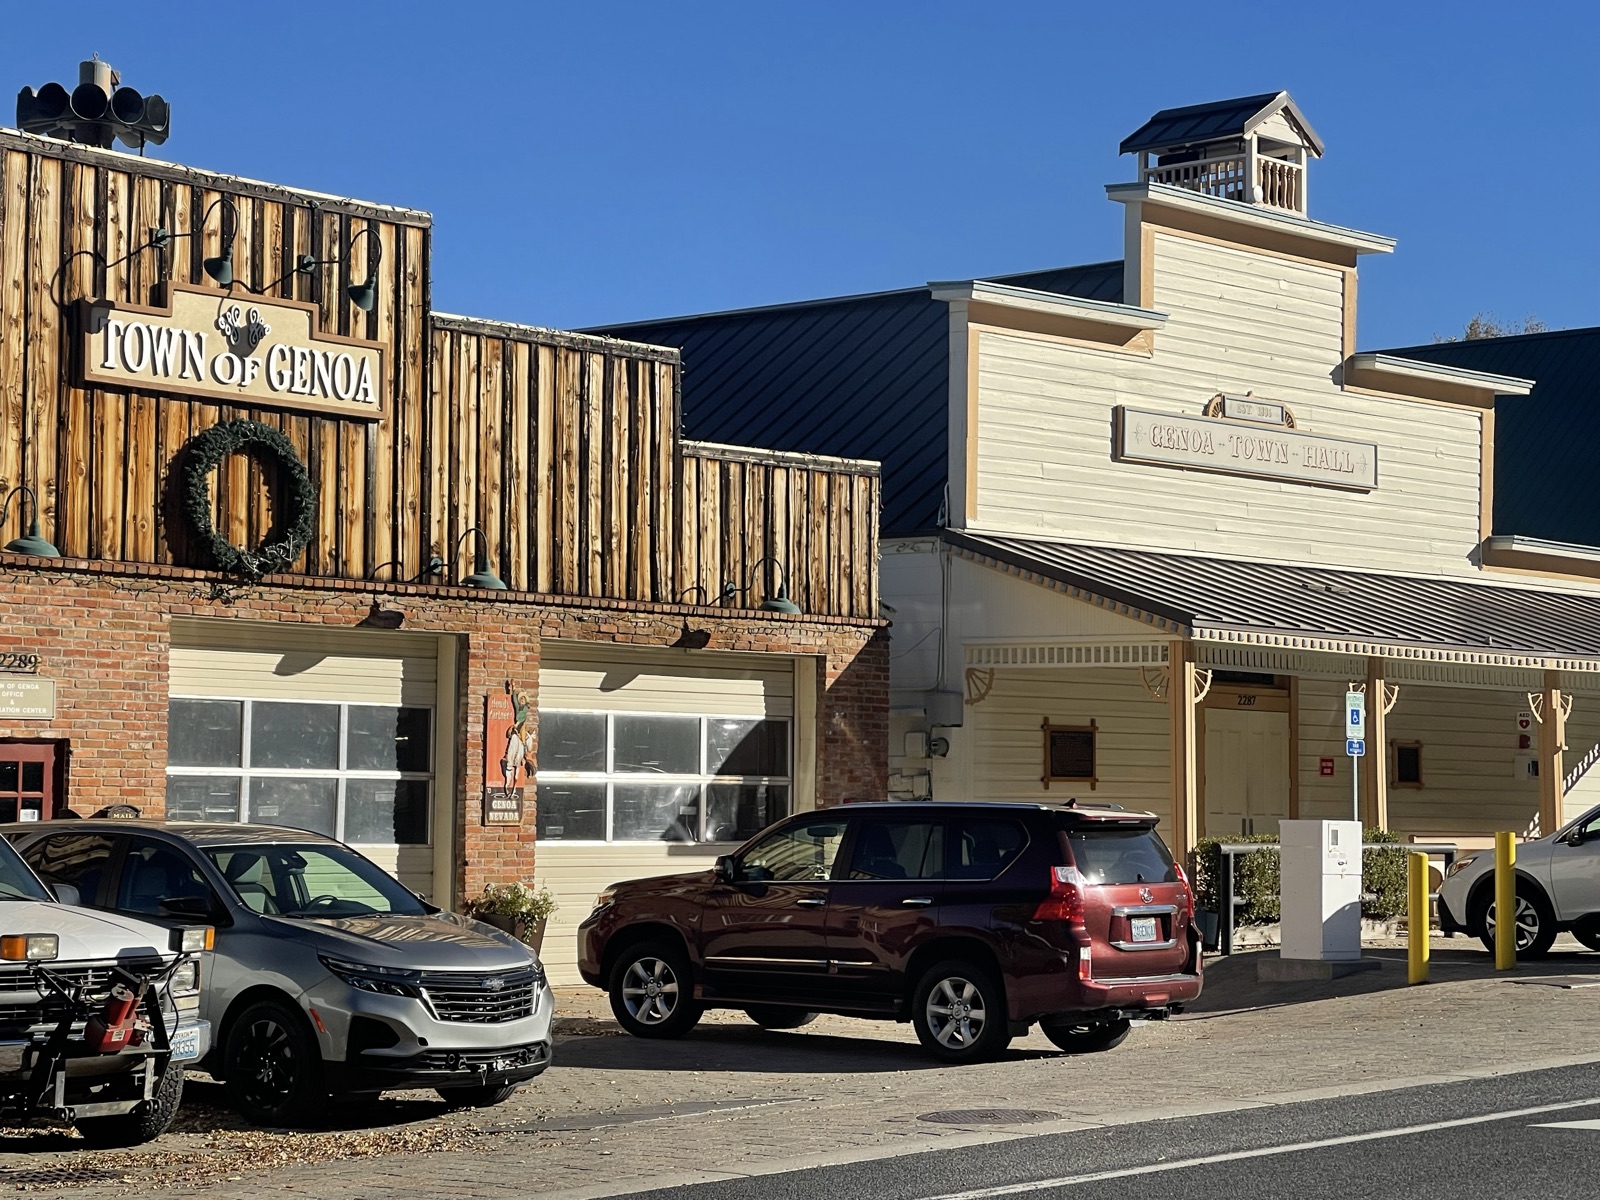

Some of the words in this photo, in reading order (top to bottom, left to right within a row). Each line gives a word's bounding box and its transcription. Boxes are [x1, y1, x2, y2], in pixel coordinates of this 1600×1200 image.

[103, 318, 209, 381] TOWN
[212, 352, 262, 387] OF
[267, 343, 377, 403] GENOA
[1149, 422, 1215, 455] GENOA
[1229, 434, 1289, 464] TOWN
[1302, 445, 1355, 474] HALL
[0, 653, 37, 669] 2289
[1237, 695, 1256, 706] 2287
[492, 800, 517, 809] GENOA
[488, 811, 519, 821] NEVADA
